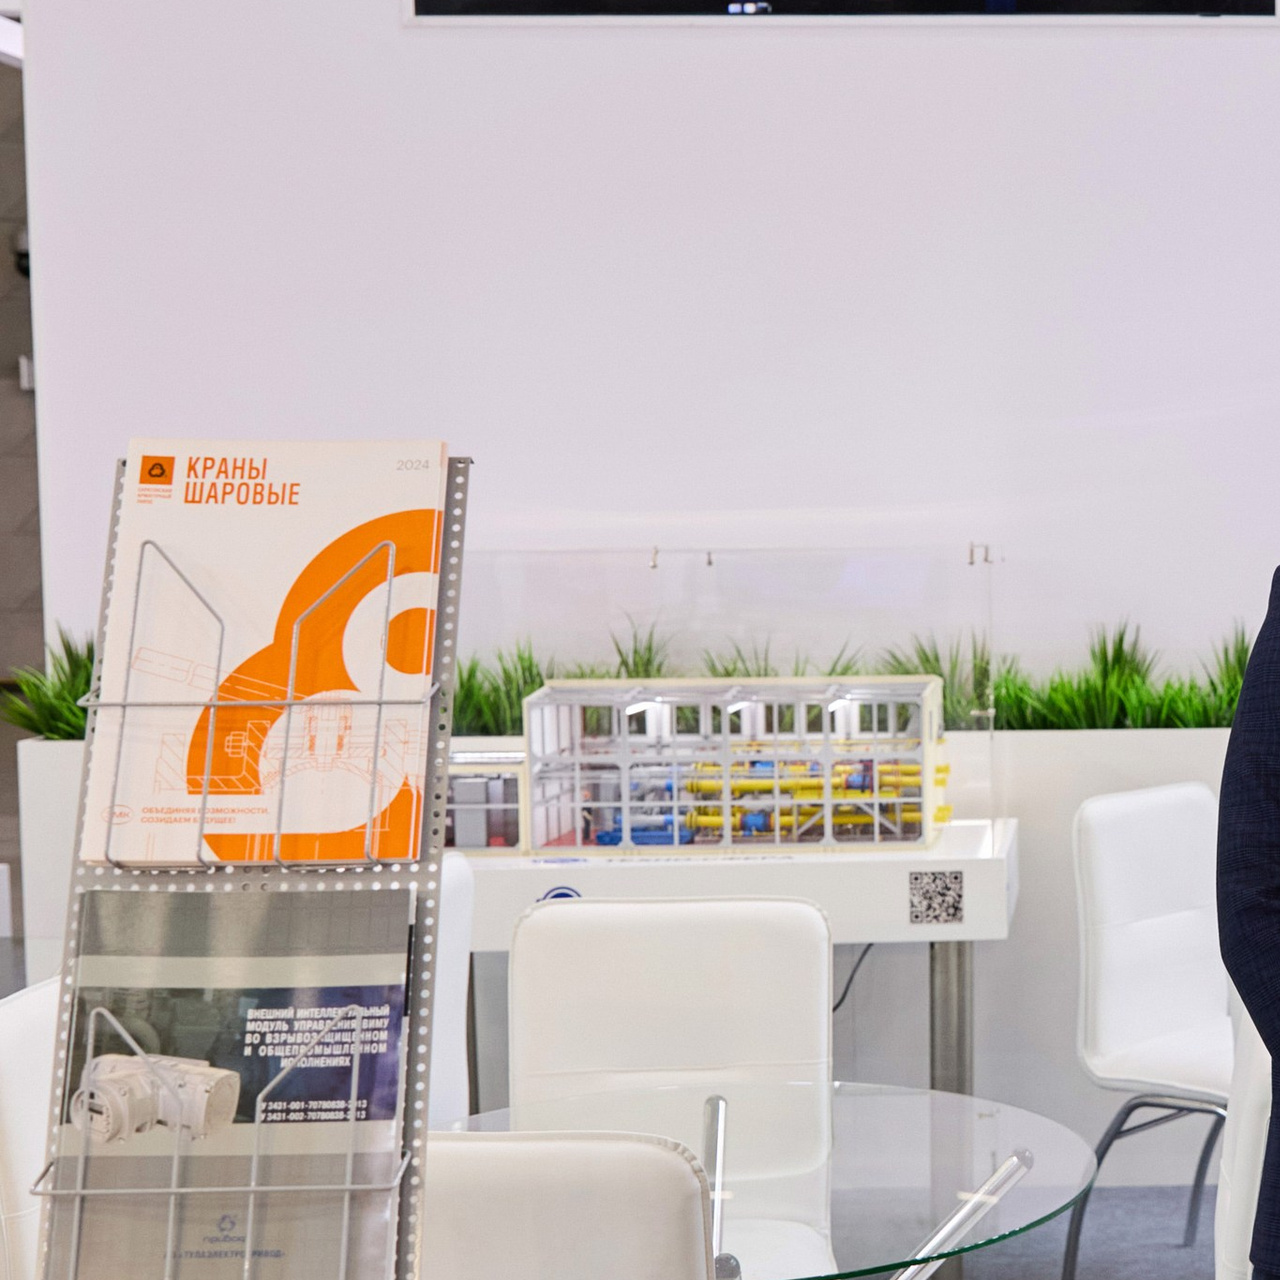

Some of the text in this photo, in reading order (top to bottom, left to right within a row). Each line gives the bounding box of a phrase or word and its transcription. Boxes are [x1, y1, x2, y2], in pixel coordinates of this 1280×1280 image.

[186, 455, 268, 480] КРАНЫ
[396, 459, 429, 471] 2024
[183, 481, 301, 506] ШАРОВЫЕ
[247, 1006, 294, 1020] ВНЕШНИЙ
[245, 1020, 289, 1033] МОДУЛЬ
[362, 1018, 390, 1029] ВИМУ
[245, 1033, 261, 1044] ВО
[243, 1046, 252, 1056] И
